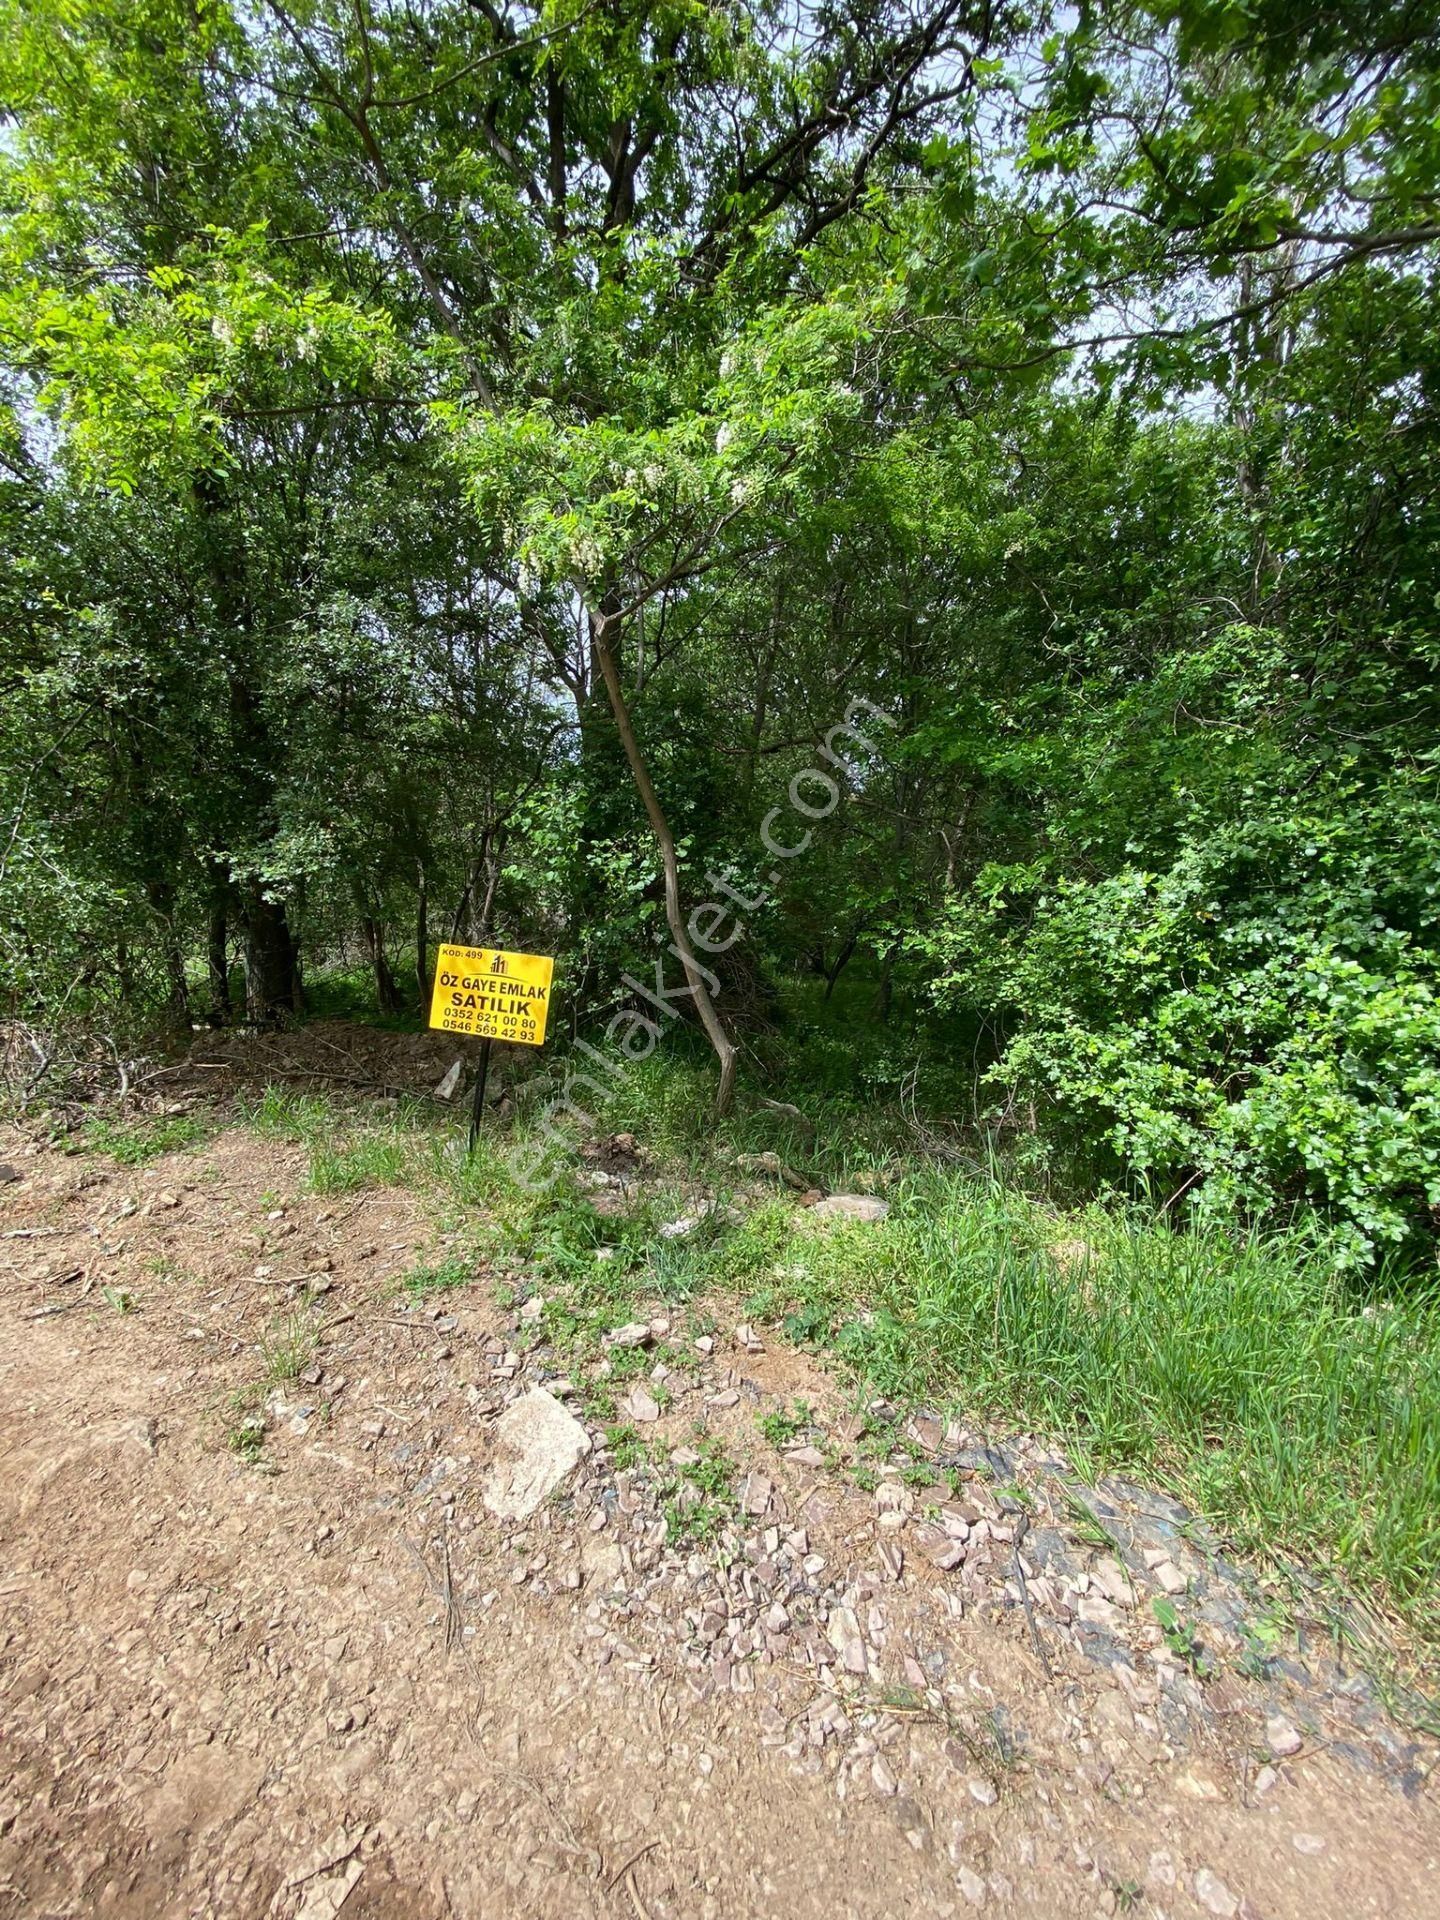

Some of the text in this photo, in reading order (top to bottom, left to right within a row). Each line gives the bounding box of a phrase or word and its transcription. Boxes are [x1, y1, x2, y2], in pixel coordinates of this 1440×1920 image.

[442, 948, 483, 959] KOD: 499
[440, 971, 547, 1000] ÖZ GAYE EMLAK
[451, 992, 531, 1016] SATILIK
[444, 1007, 536, 1029] 0352 621 00 80
[442, 1019, 535, 1041] 0546 569 42 93
